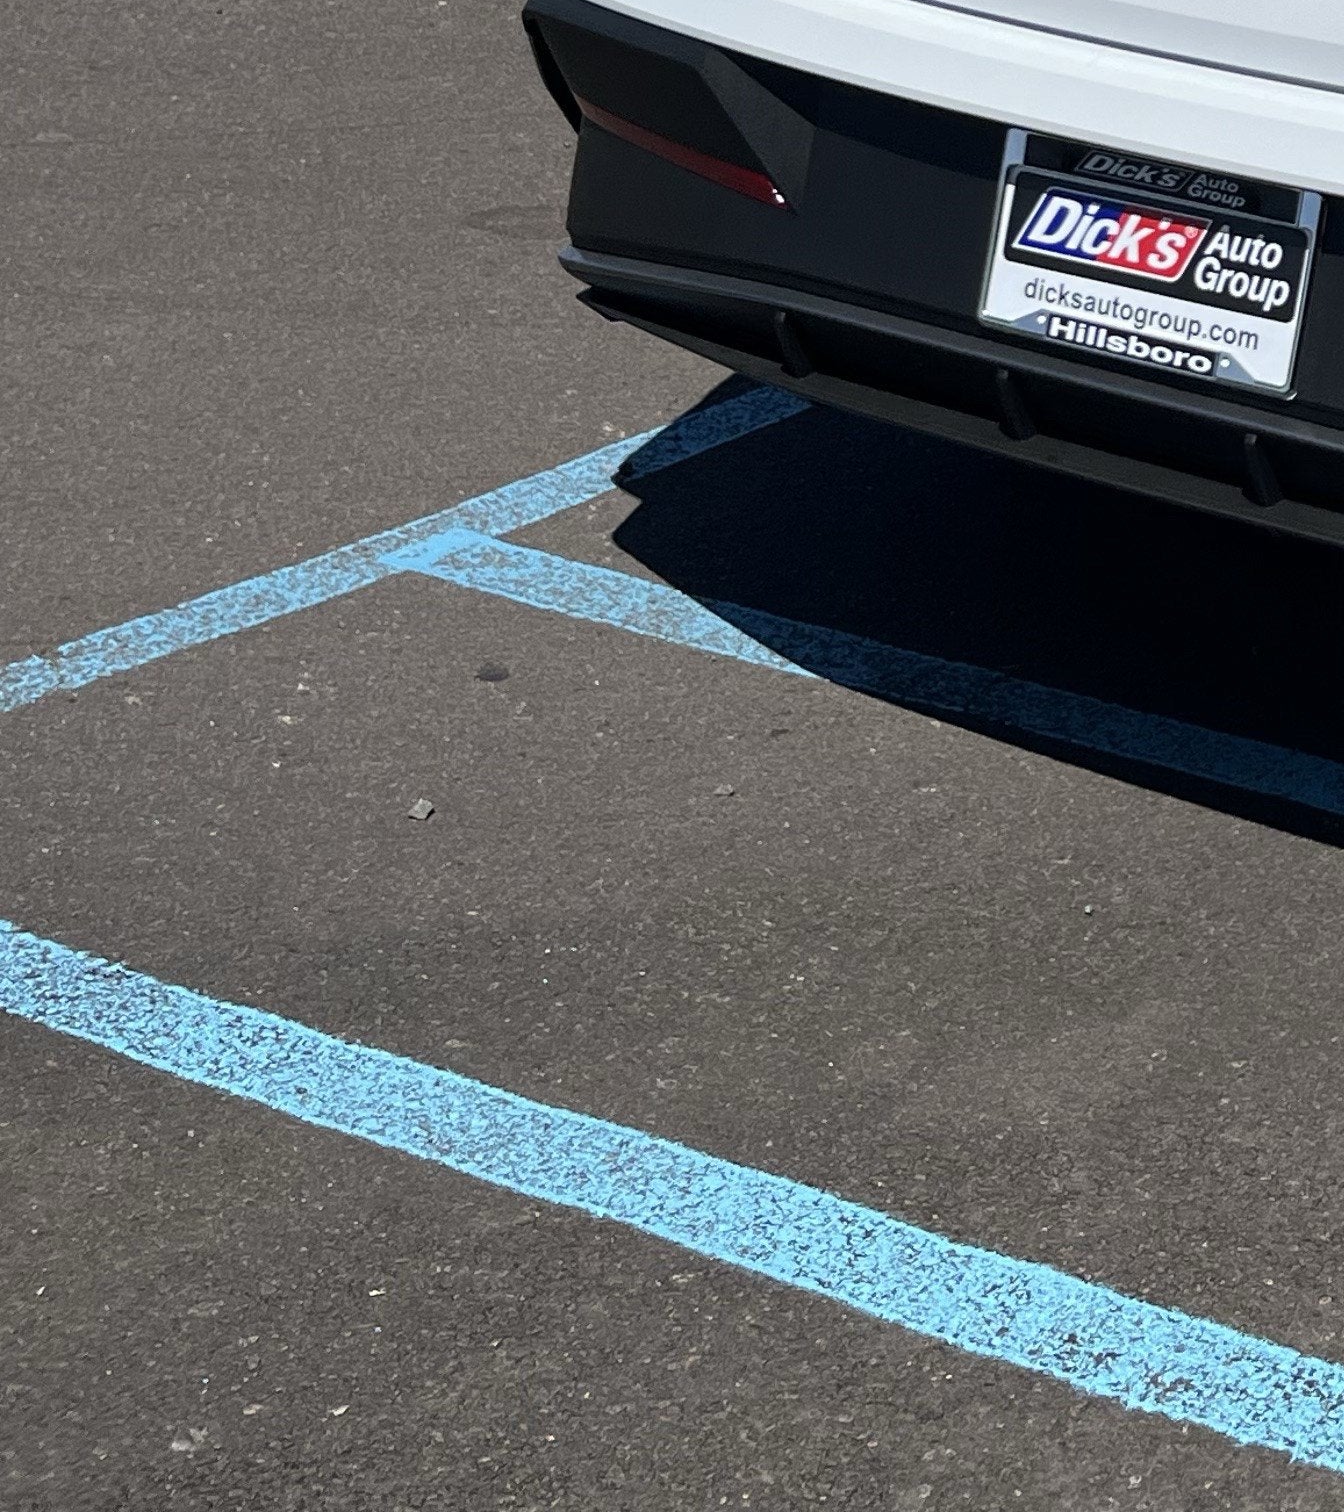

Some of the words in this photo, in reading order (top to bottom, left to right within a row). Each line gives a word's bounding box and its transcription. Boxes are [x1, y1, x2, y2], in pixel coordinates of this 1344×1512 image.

[1084, 153, 1183, 188] Dick's
[1192, 173, 1239, 193] Auto
[1186, 184, 1246, 208] Group
[1026, 192, 1187, 270] Dick's
[1203, 230, 1284, 270] Auto
[1193, 256, 1291, 312] Group
[1023, 278, 1260, 350] dicksautogroup.com
[1049, 316, 1213, 373] Hillsboro
